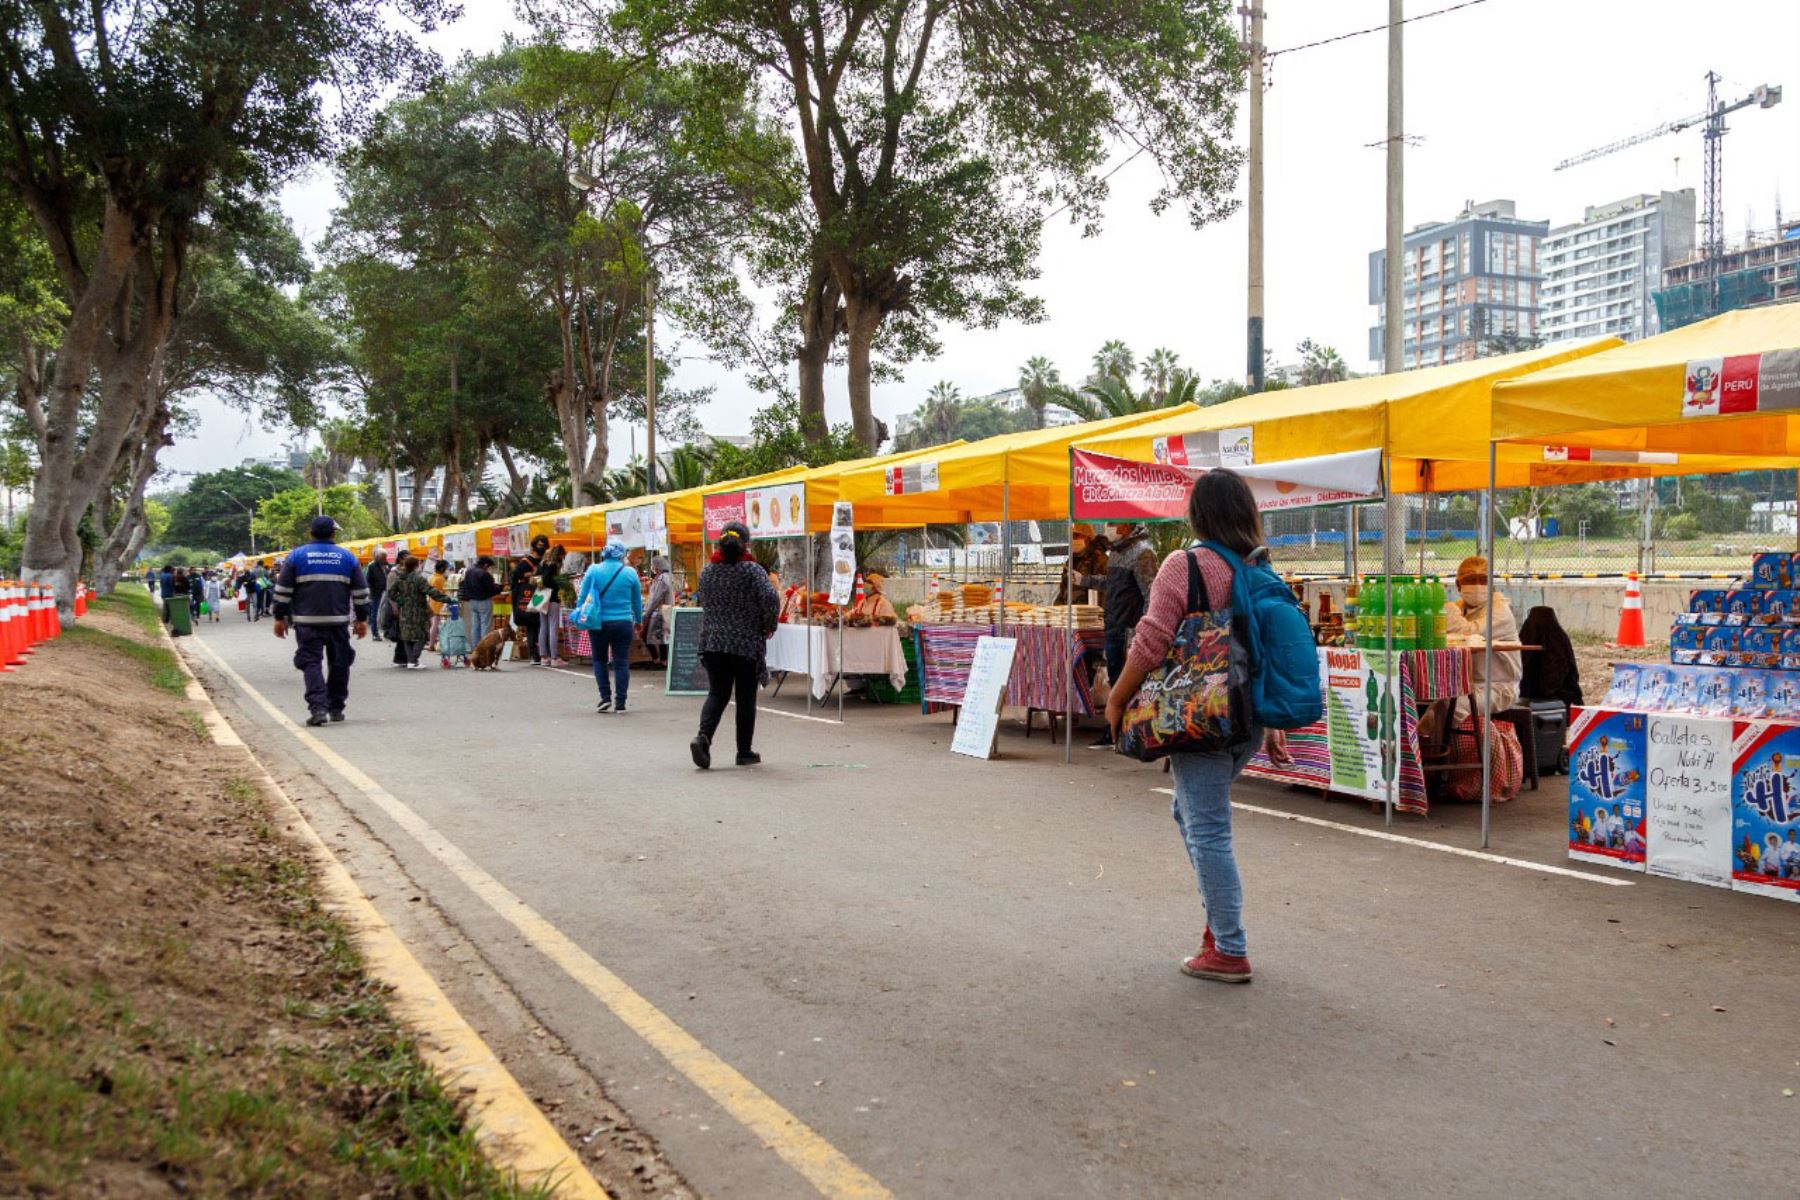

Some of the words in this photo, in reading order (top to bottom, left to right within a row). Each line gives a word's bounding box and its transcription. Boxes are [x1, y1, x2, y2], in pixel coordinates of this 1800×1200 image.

[1327, 650, 1360, 671] Nopal
[1650, 721, 1712, 746] Galletas
[1650, 767, 1690, 792] Oferta
